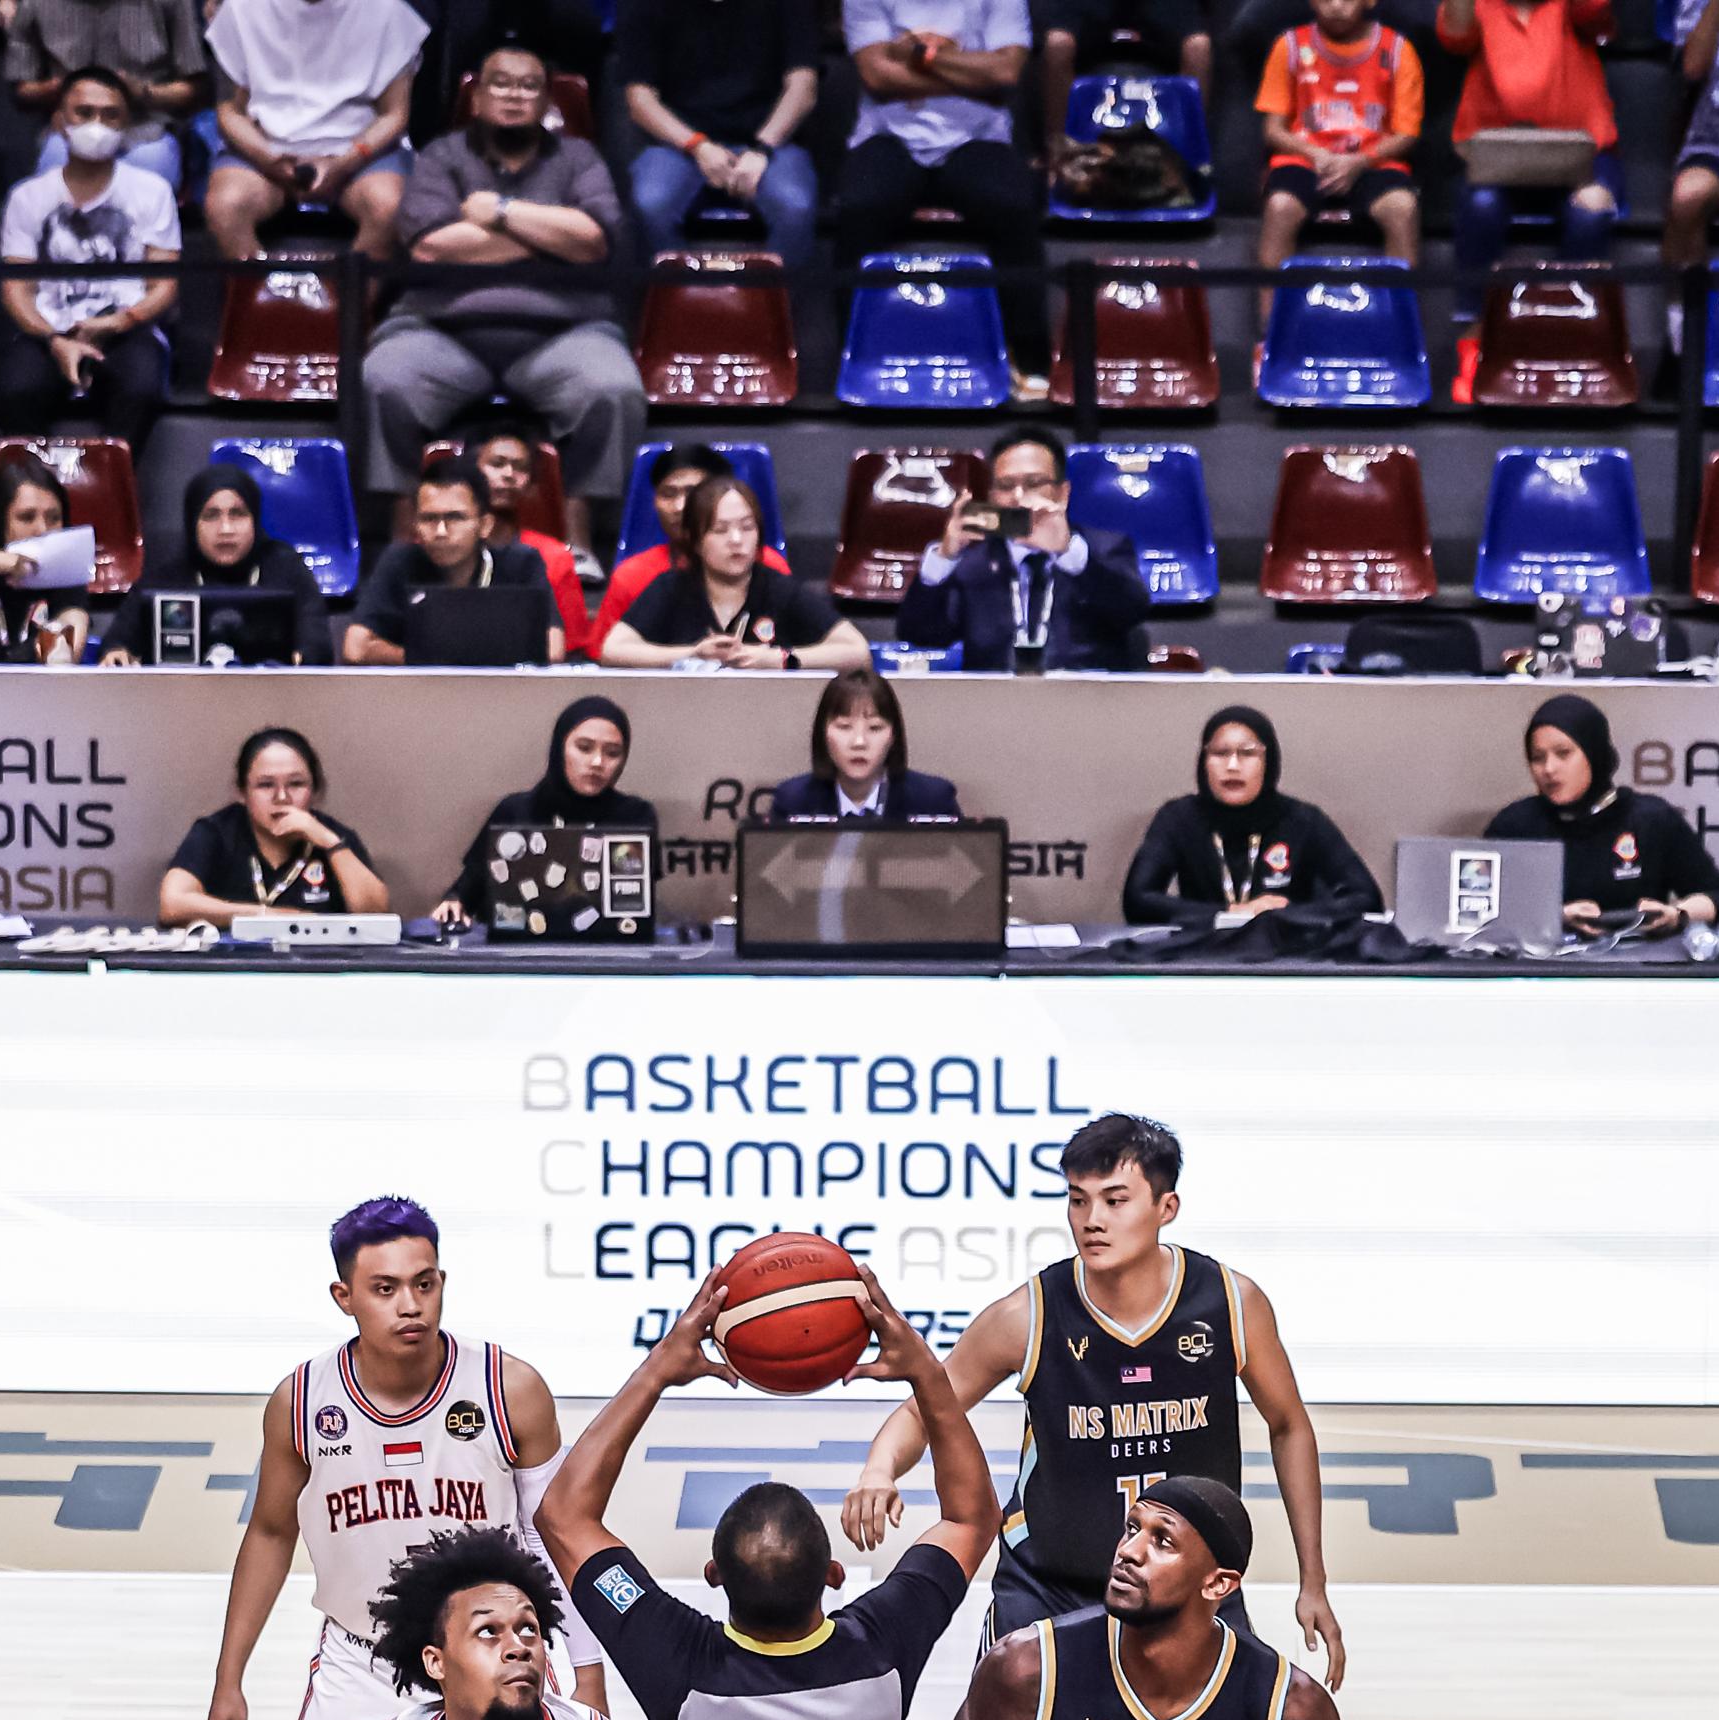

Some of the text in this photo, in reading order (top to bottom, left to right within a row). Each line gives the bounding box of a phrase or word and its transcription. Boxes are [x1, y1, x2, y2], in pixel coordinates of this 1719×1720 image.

[522, 1054, 1093, 1115] BASKETBALL
[540, 1139, 1067, 1199] CHAMPIONS
[1178, 1333, 1214, 1350] BCL
[447, 1412, 485, 1429] BCL
[1068, 1396, 1209, 1440] NS MATRIX
[1111, 1438, 1171, 1459] DEERS
[326, 1477, 488, 1533] PELITA JAYA
